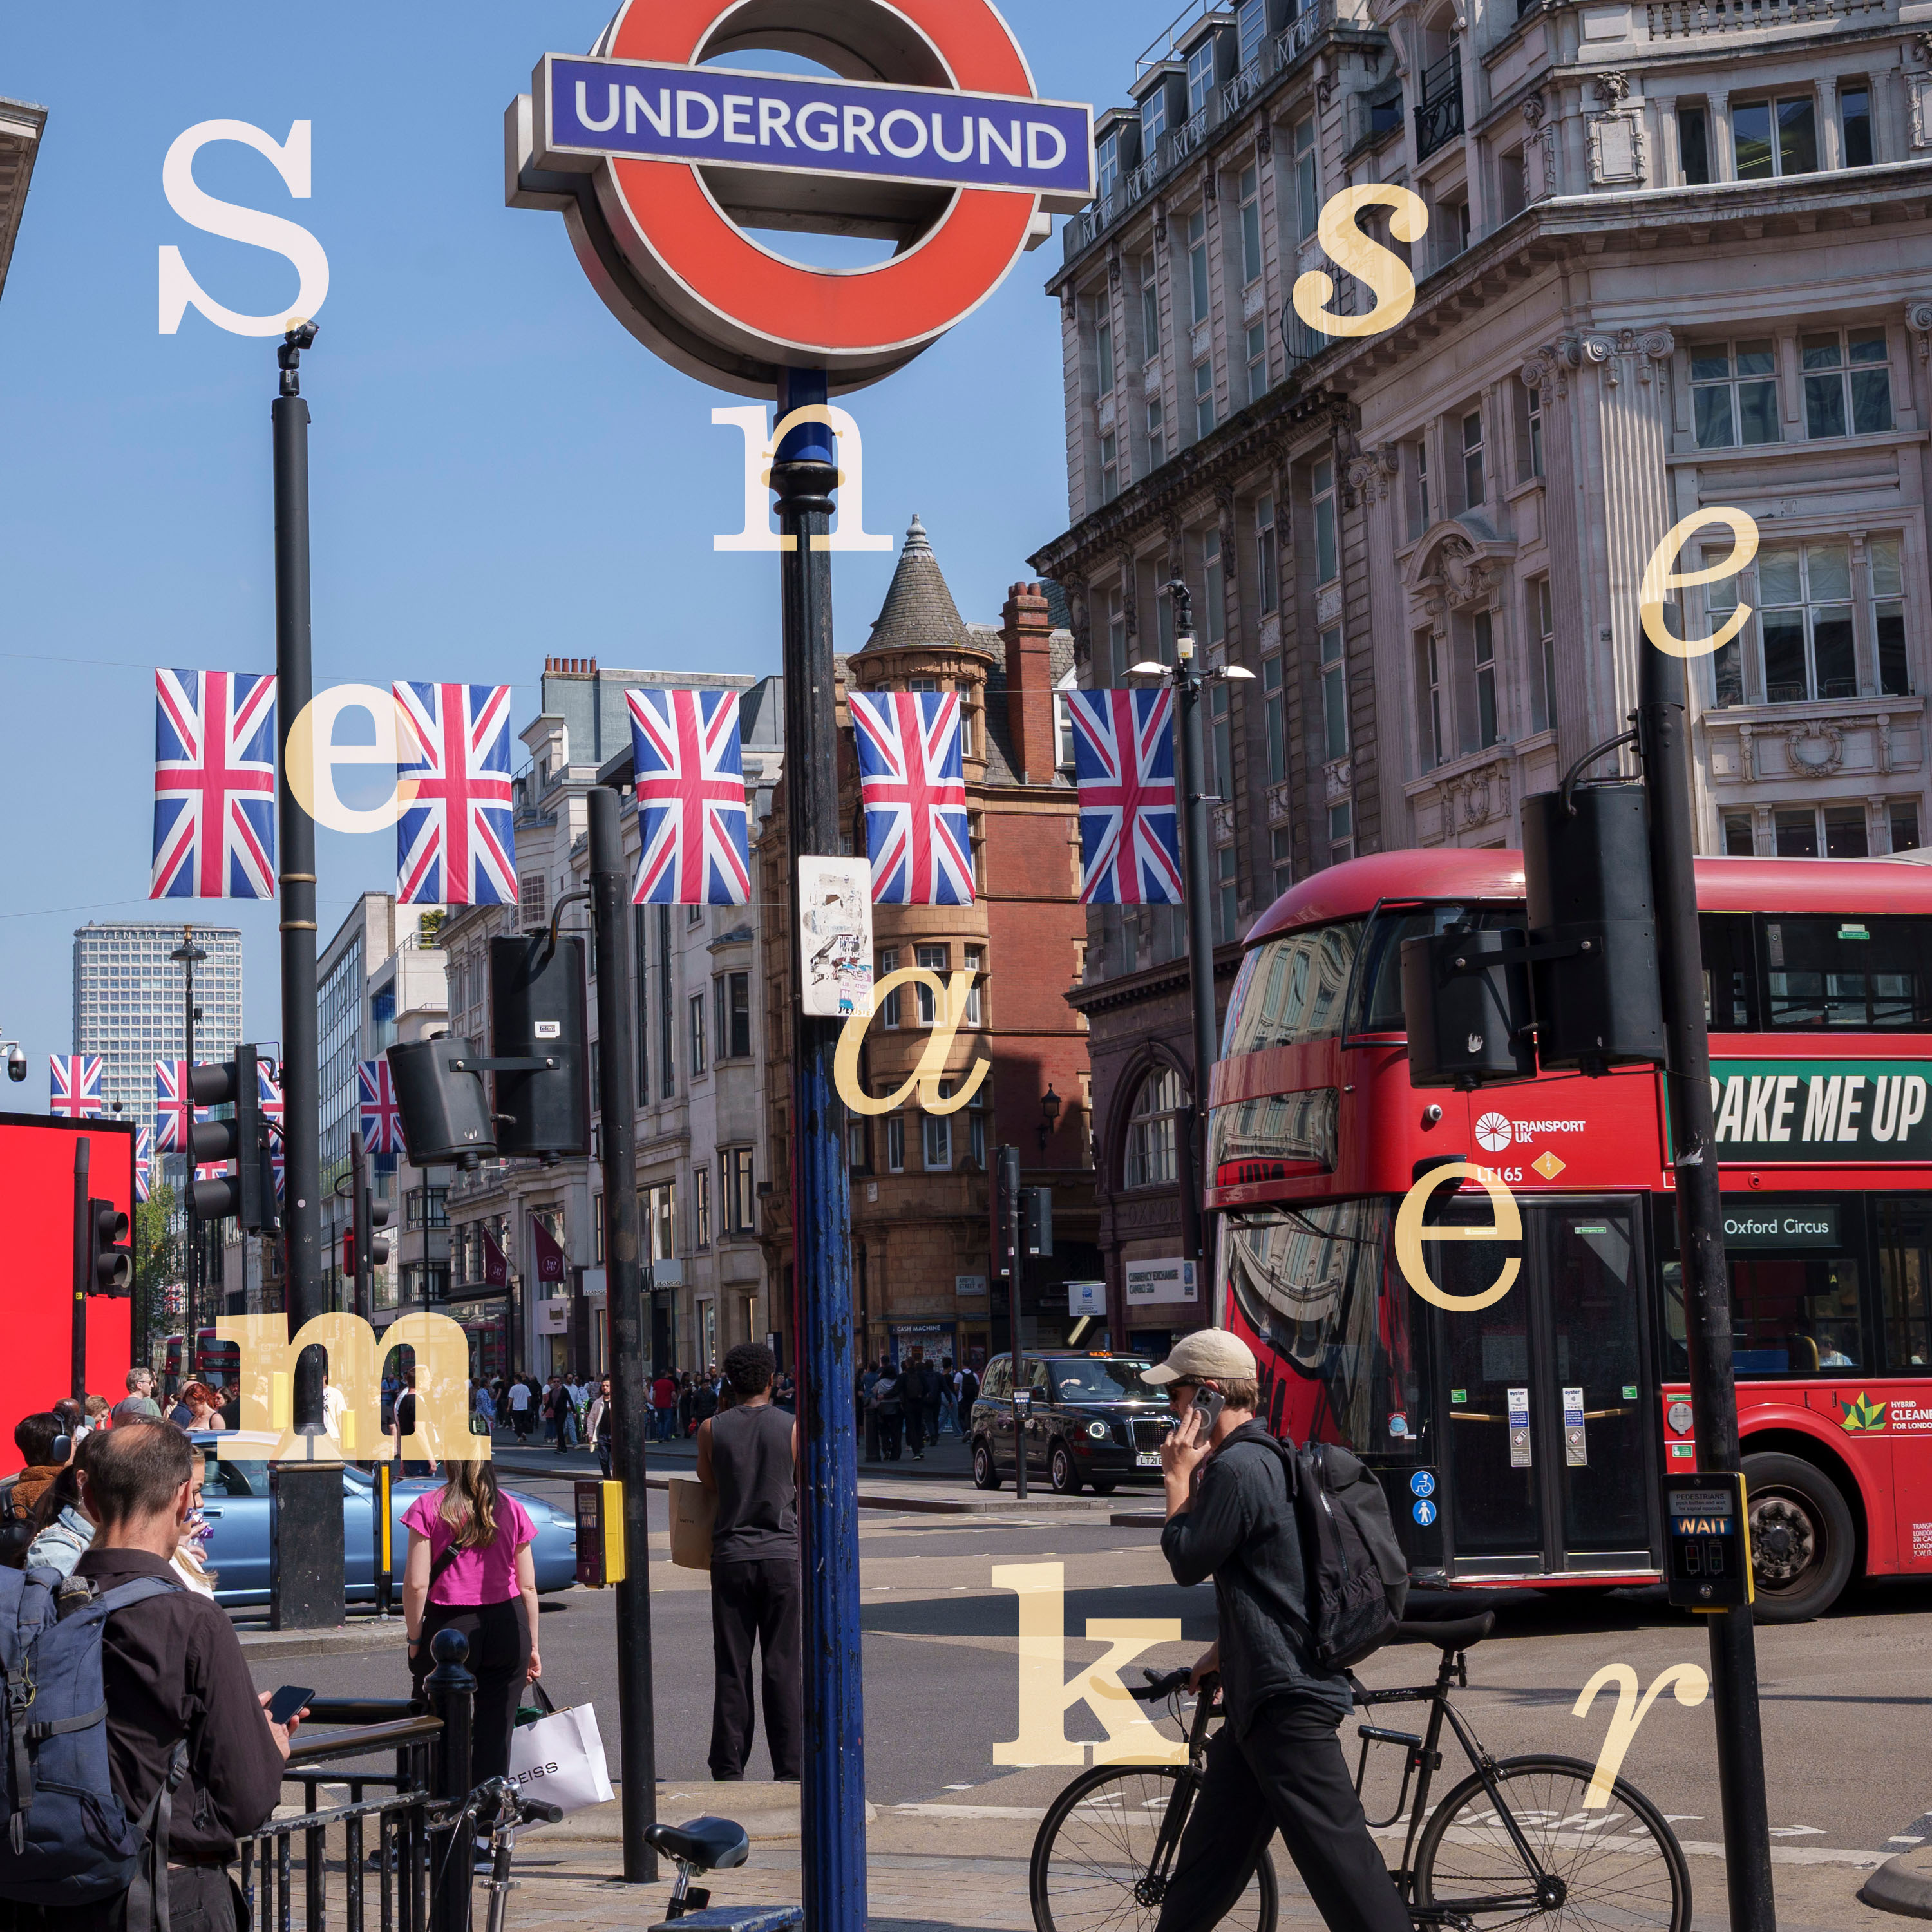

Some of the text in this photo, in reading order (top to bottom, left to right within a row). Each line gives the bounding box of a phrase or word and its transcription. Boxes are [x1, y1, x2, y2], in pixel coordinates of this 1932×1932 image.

[575, 80, 1067, 170] UNDERGROUND
[103, 931, 161, 940] CENTRE
[1801, 1075, 1866, 1142] ME
[1871, 1075, 1927, 1142] UP
[1511, 1121, 1587, 1132] TRANSPORT
[1515, 1132, 1534, 1143] UK
[1476, 1167, 1523, 1182] LT165
[1128, 1200, 1180, 1226] OXFOR
[1724, 1218, 1830, 1235] Oxford Circus
[1908, 1421, 1932, 1430] LONDO
[1676, 1517, 1728, 1534] WAIT
